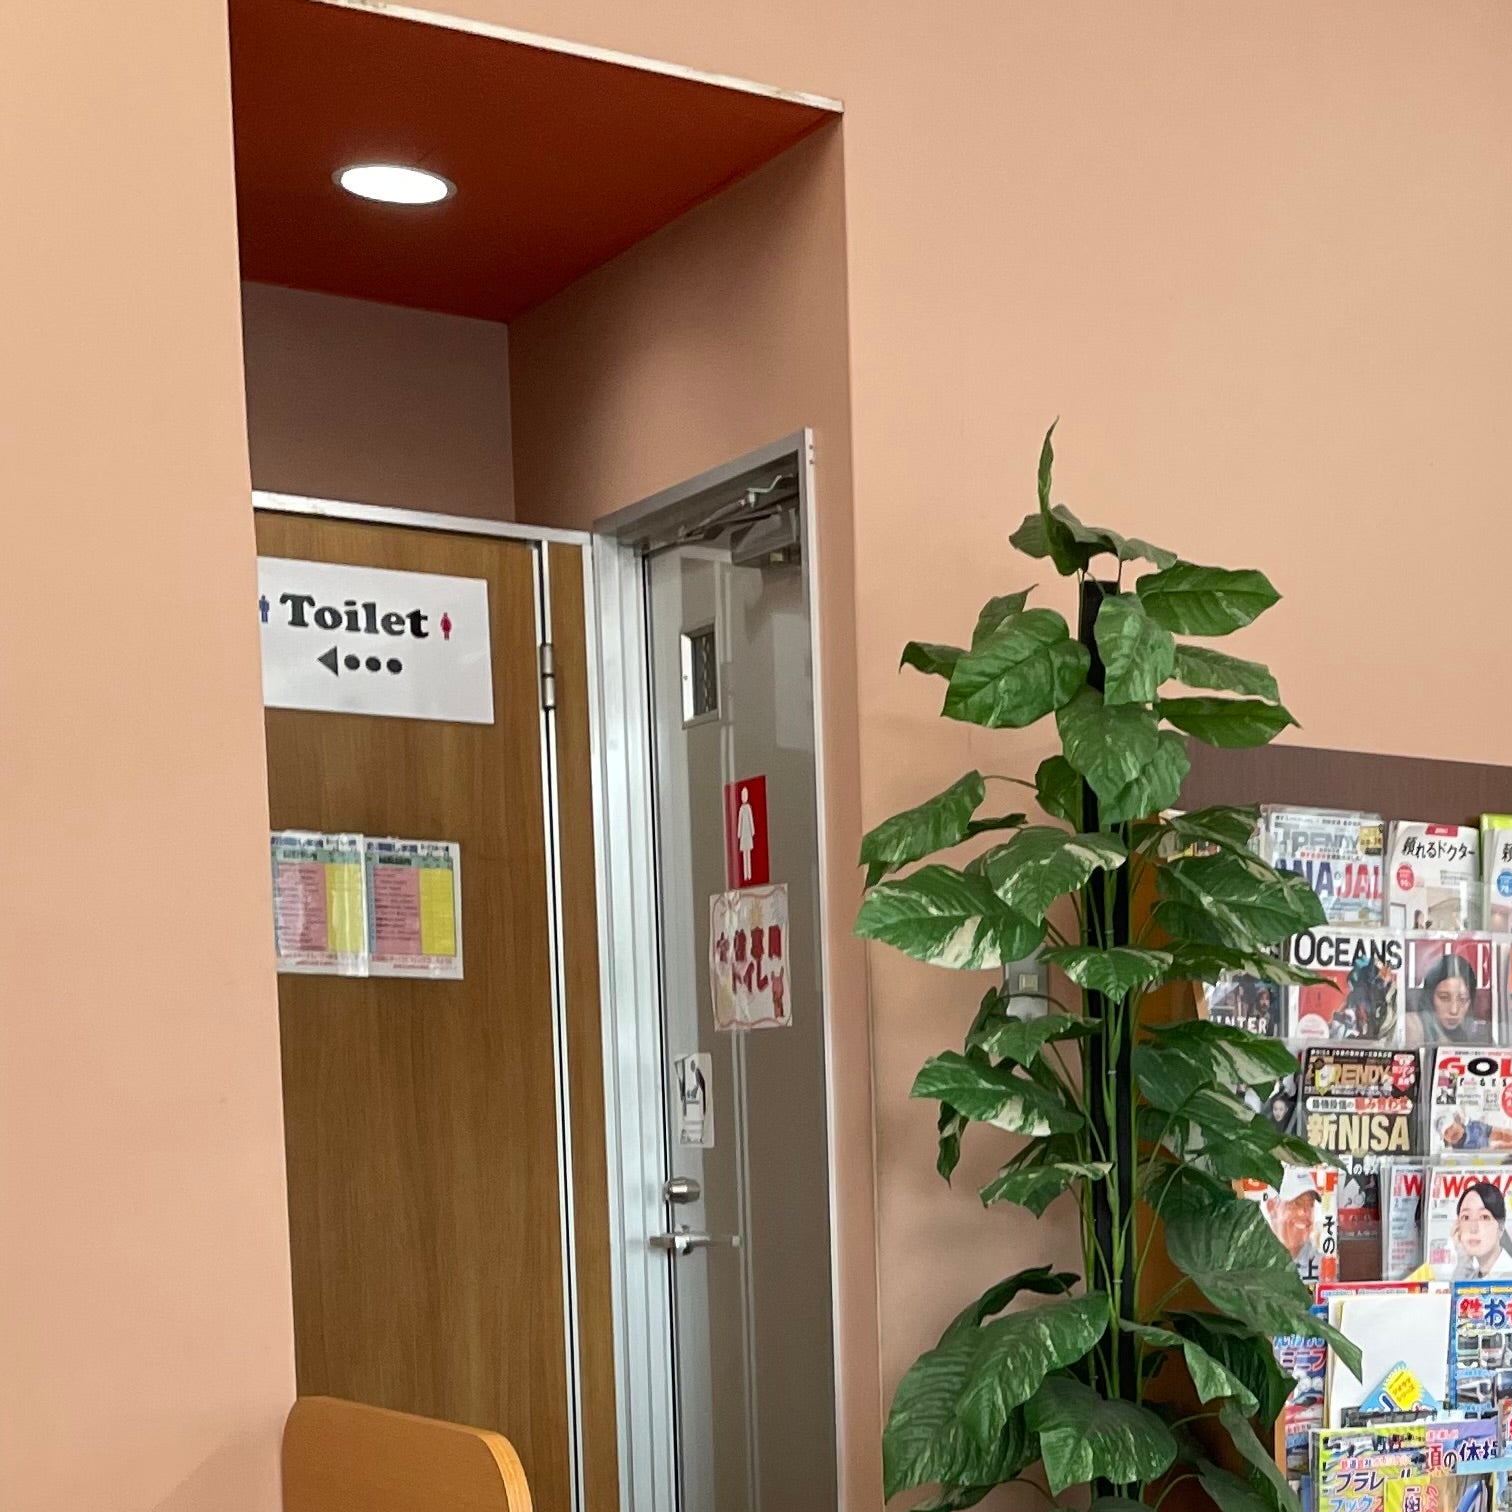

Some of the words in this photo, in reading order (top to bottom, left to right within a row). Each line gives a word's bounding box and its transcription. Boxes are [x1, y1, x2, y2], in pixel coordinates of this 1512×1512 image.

[279, 592, 430, 639] Toilet
[1402, 835, 1476, 862] 頼れるドクター
[1294, 928, 1403, 970] OCEANS
[1306, 1113, 1411, 1153] 新NISA
